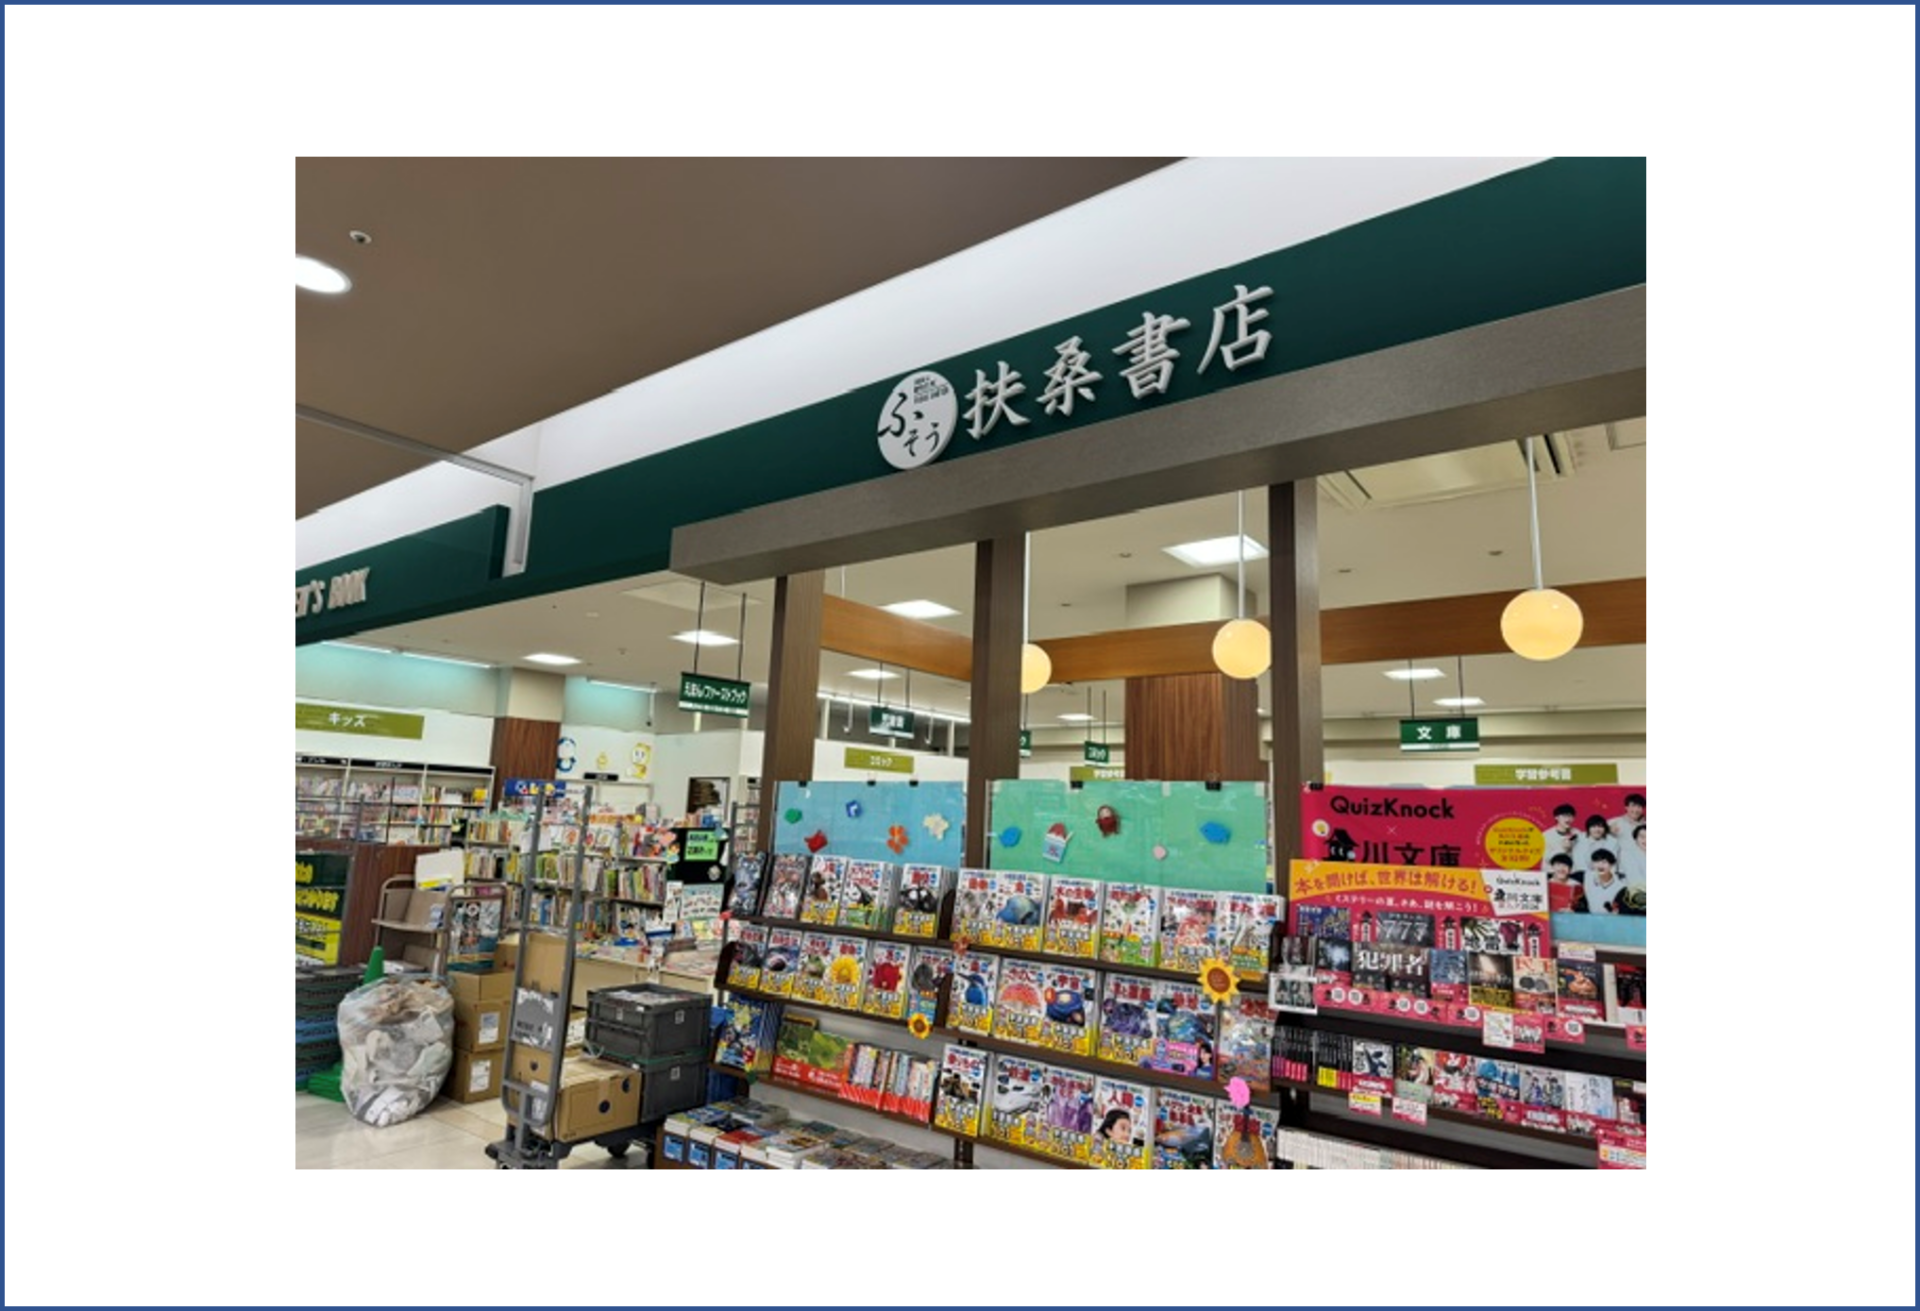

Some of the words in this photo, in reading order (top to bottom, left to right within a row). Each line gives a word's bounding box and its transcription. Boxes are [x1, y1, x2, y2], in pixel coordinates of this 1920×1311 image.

[962, 284, 1274, 440] 扶桑書店
[877, 391, 941, 458] ふそう
[328, 566, 371, 610] BOOK
[328, 711, 366, 728] キッズ
[1416, 725, 1461, 741] 文庫
[1330, 795, 1455, 819] QuizKnock
